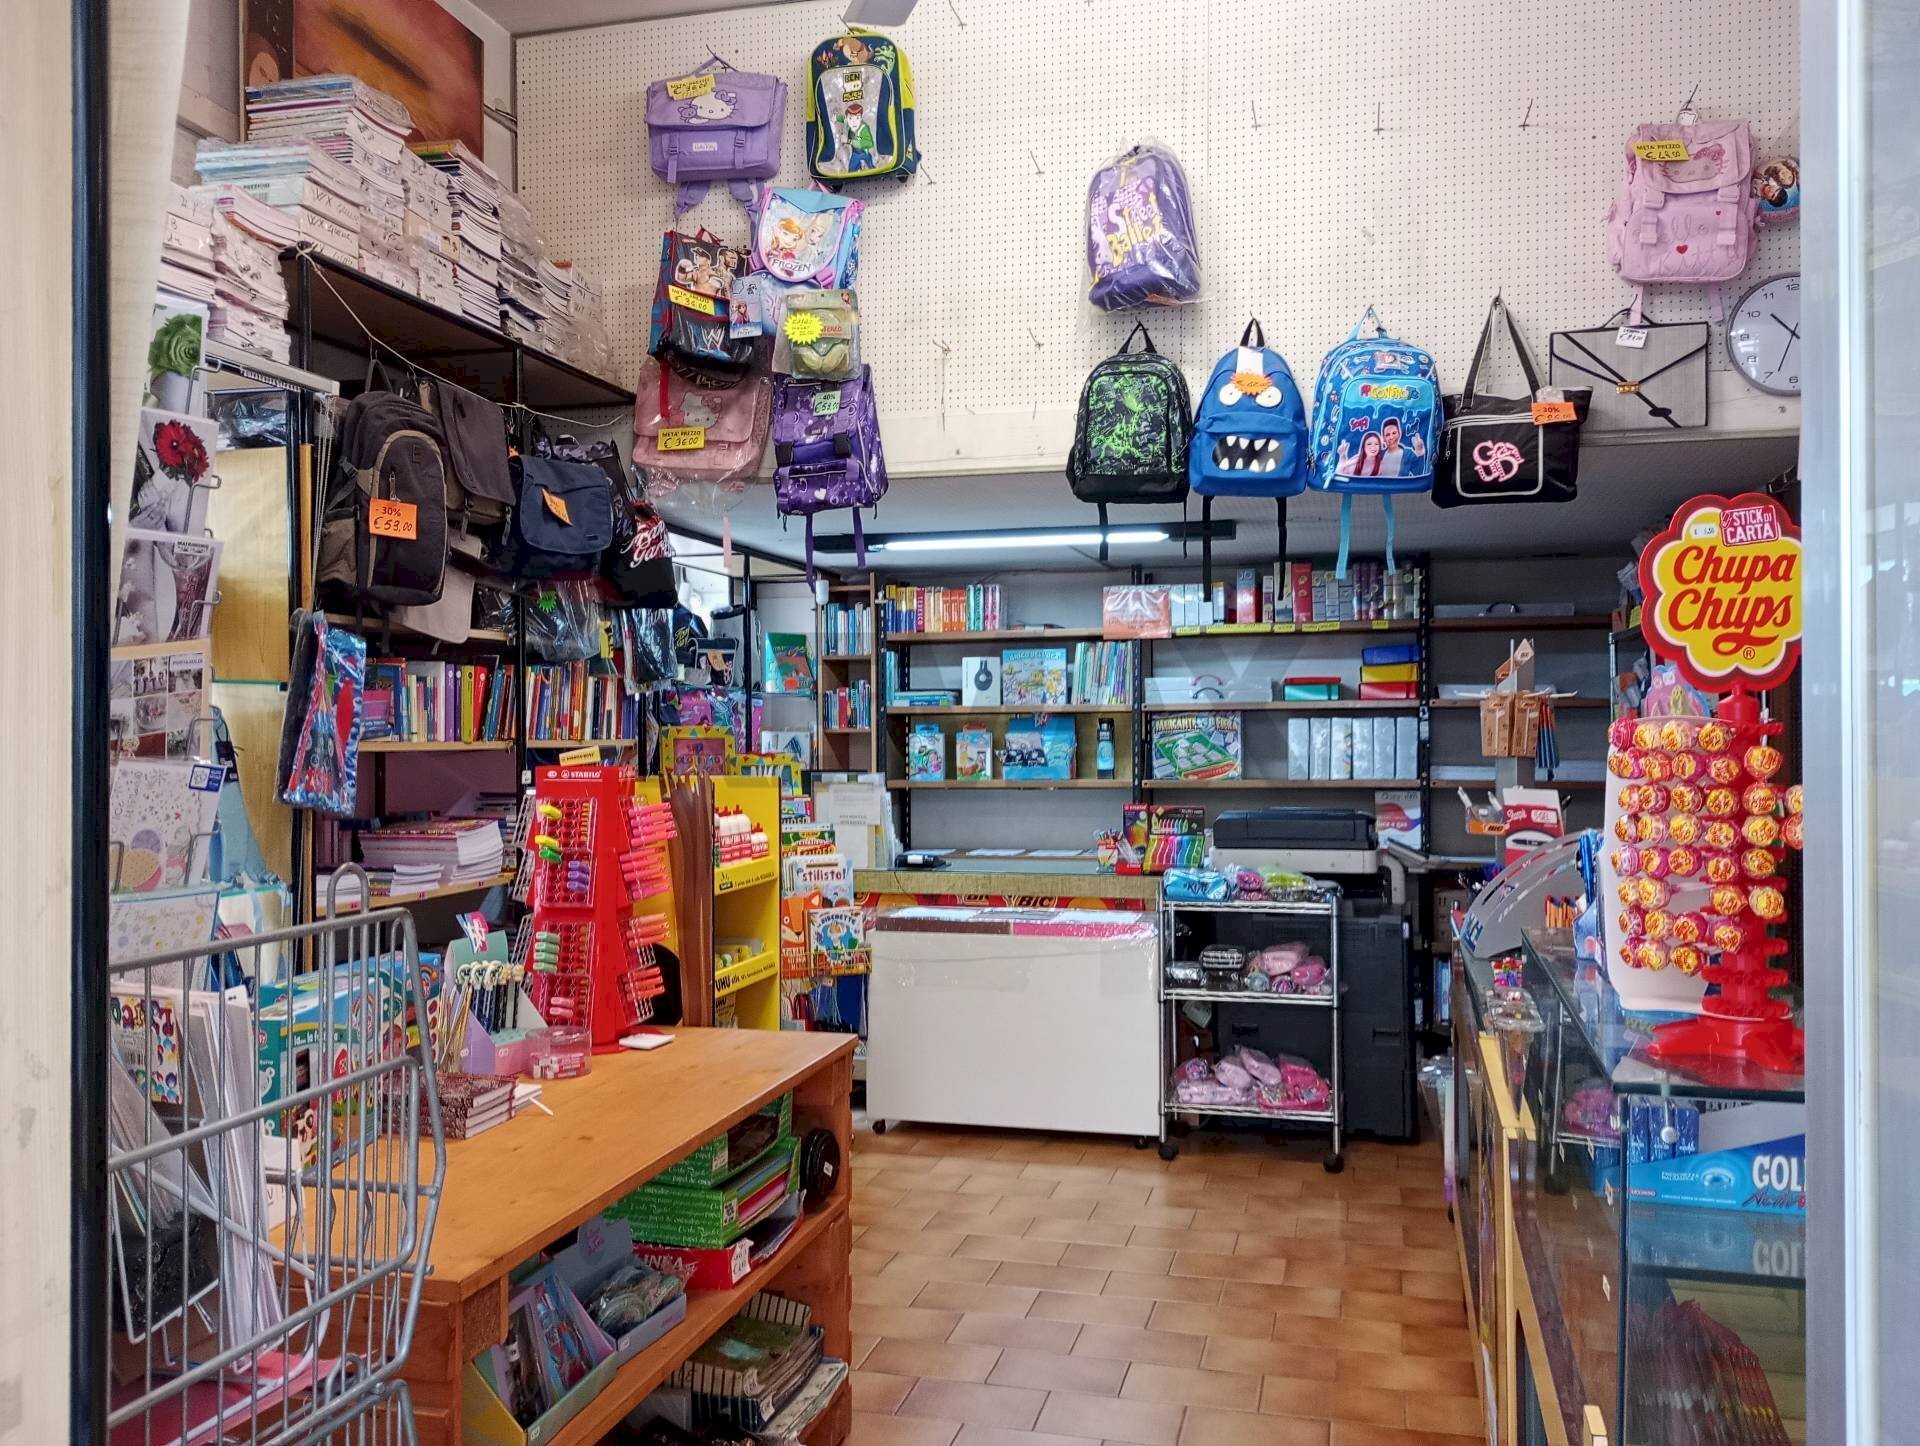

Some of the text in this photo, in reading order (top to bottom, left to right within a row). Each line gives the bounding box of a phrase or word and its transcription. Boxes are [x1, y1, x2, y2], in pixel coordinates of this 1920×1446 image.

[844, 74, 860, 82] BEN
[771, 257, 813, 273] FROZEN
[1748, 310, 1761, 318] 10
[1789, 376, 1799, 384] 6
[1733, 510, 1773, 525] STICK DI
[1727, 525, 1774, 543] CARTA
[1673, 545, 1797, 594] Chupa
[1668, 587, 1794, 656] Chups
[1018, 895, 1053, 906] BIC
[715, 975, 731, 992] UHU
